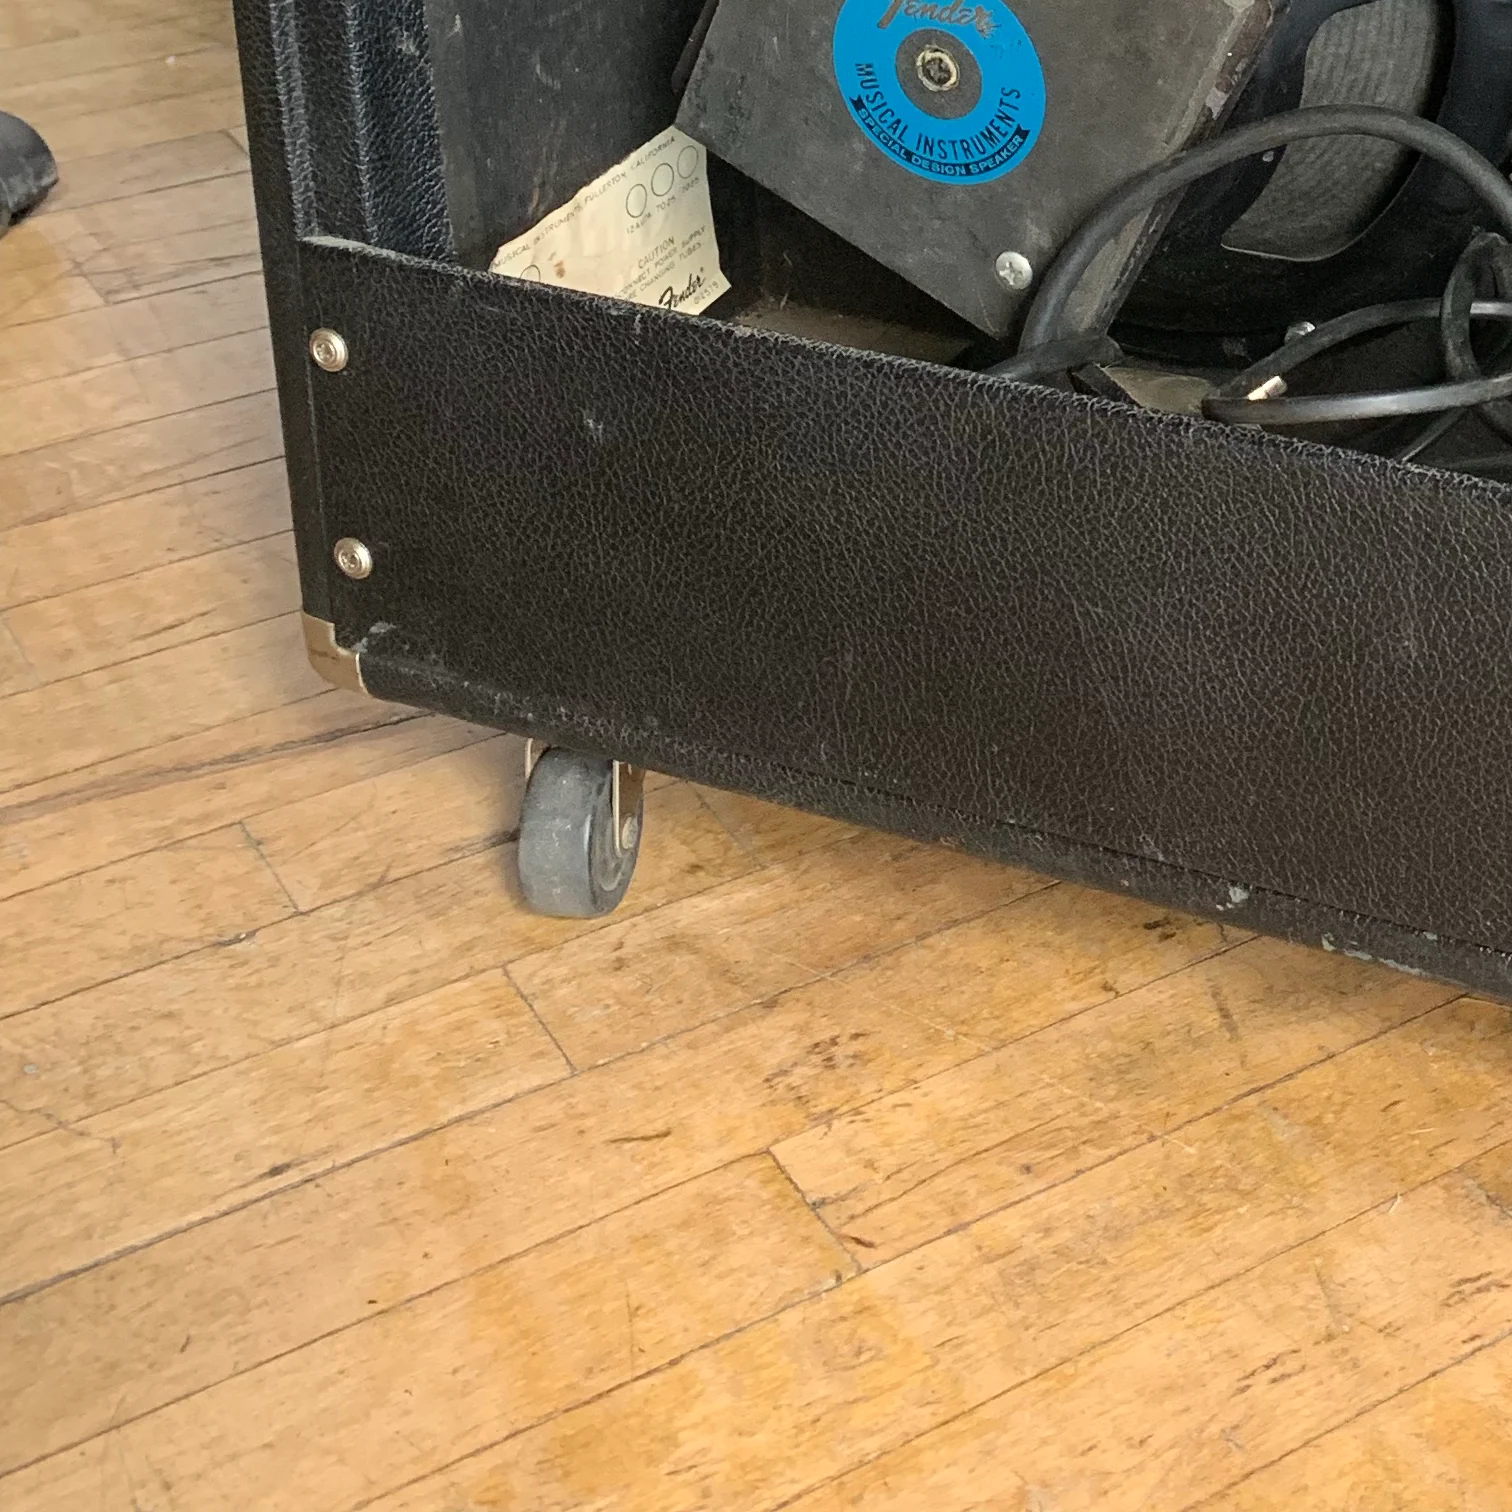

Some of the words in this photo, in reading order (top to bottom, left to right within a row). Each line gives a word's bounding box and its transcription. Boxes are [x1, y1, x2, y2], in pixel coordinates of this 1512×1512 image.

[855, 63, 909, 144] MUSICAL
[915, 87, 1021, 161] INSTRUMENTS
[857, 107, 912, 160] SPECIAL
[911, 154, 967, 177] DESIGN
[968, 135, 1024, 174] SPEAKER
[638, 236, 675, 269] CAUTION
[659, 273, 707, 310] Fender
